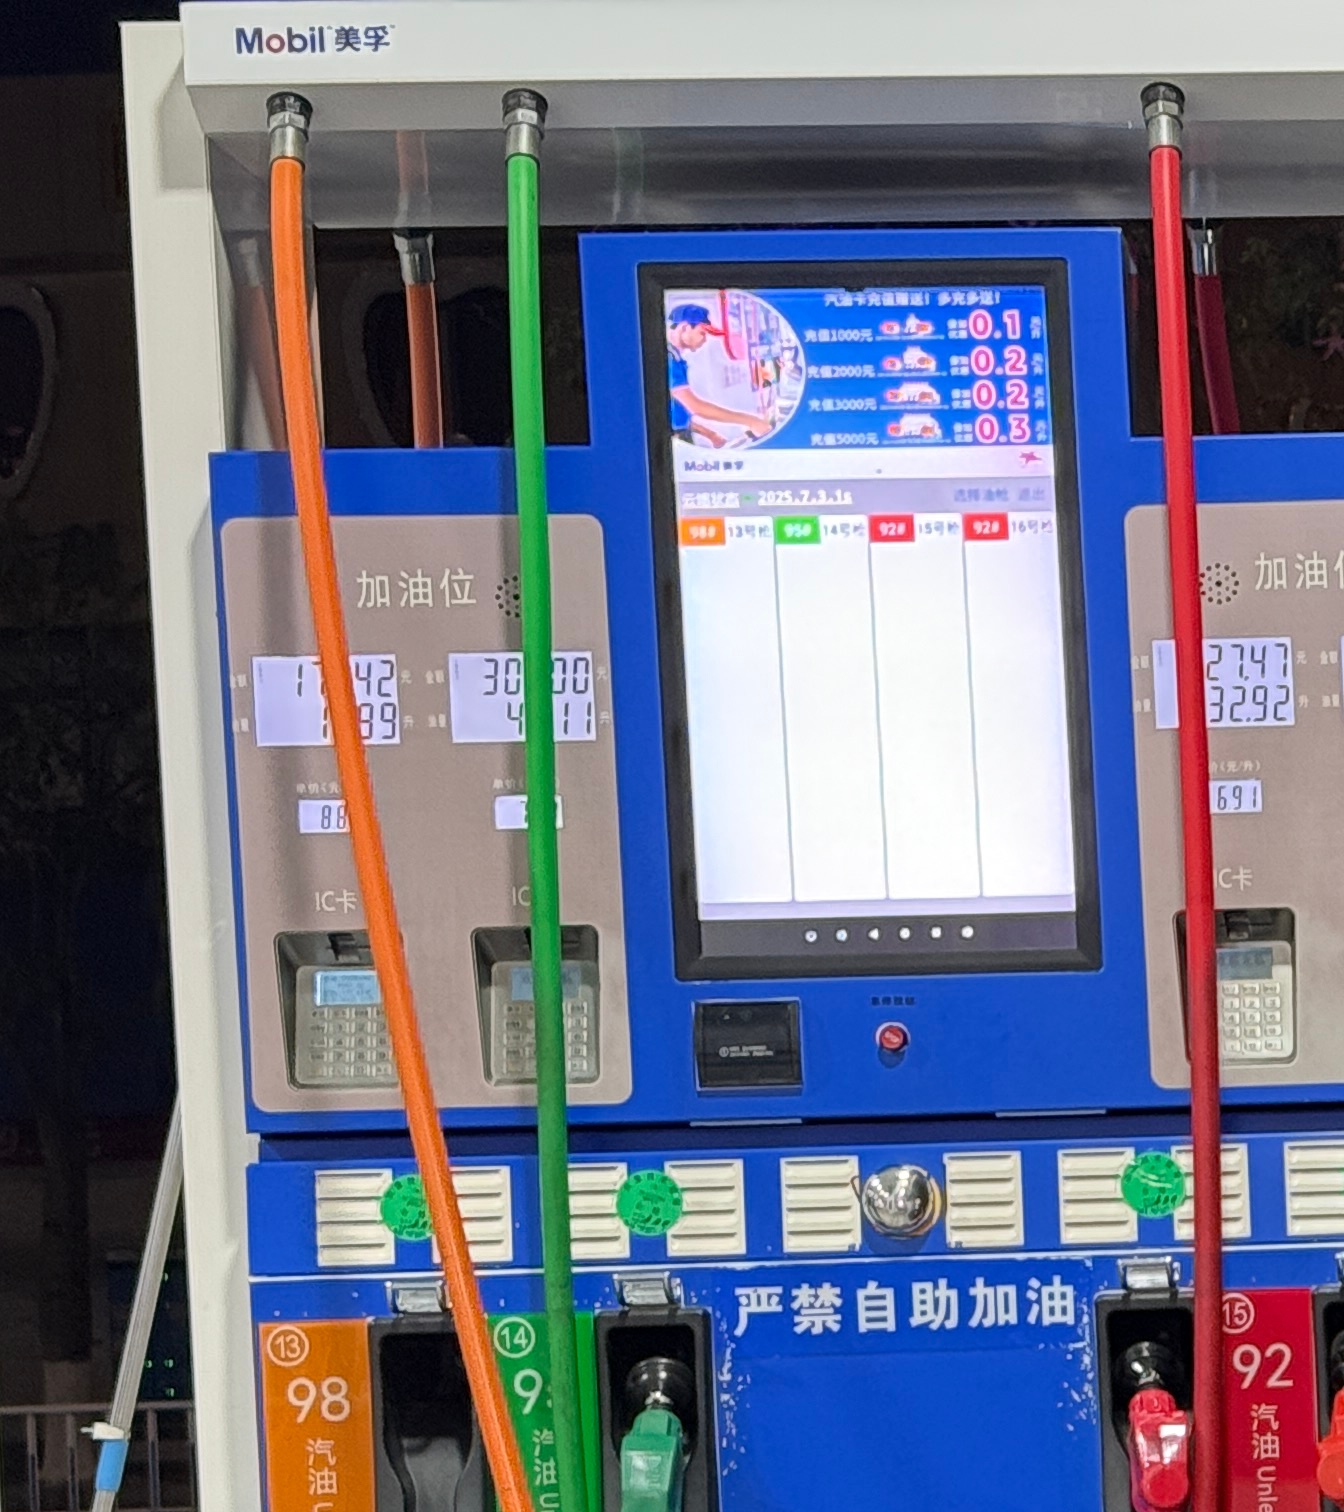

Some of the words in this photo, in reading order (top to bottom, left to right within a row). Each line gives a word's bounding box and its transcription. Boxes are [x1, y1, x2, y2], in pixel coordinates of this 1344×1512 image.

[235, 26, 326, 54] Mobil
[335, 26, 391, 52] 美孚
[969, 309, 1020, 340] 0.1
[971, 345, 1027, 376] 0.2
[973, 379, 1028, 409] 0.2
[975, 413, 1030, 443] 0.3
[356, 567, 477, 610] 加油位
[1210, 685, 1290, 723] 32.92
[315, 889, 357, 913] IC卡
[733, 1274, 1076, 1337] 严禁自助加油
[1232, 1343, 1294, 1390] 92
[287, 1376, 351, 1424] 98
[1250, 1402, 1281, 1461] 汽油
[305, 1437, 338, 1496] 汽油
